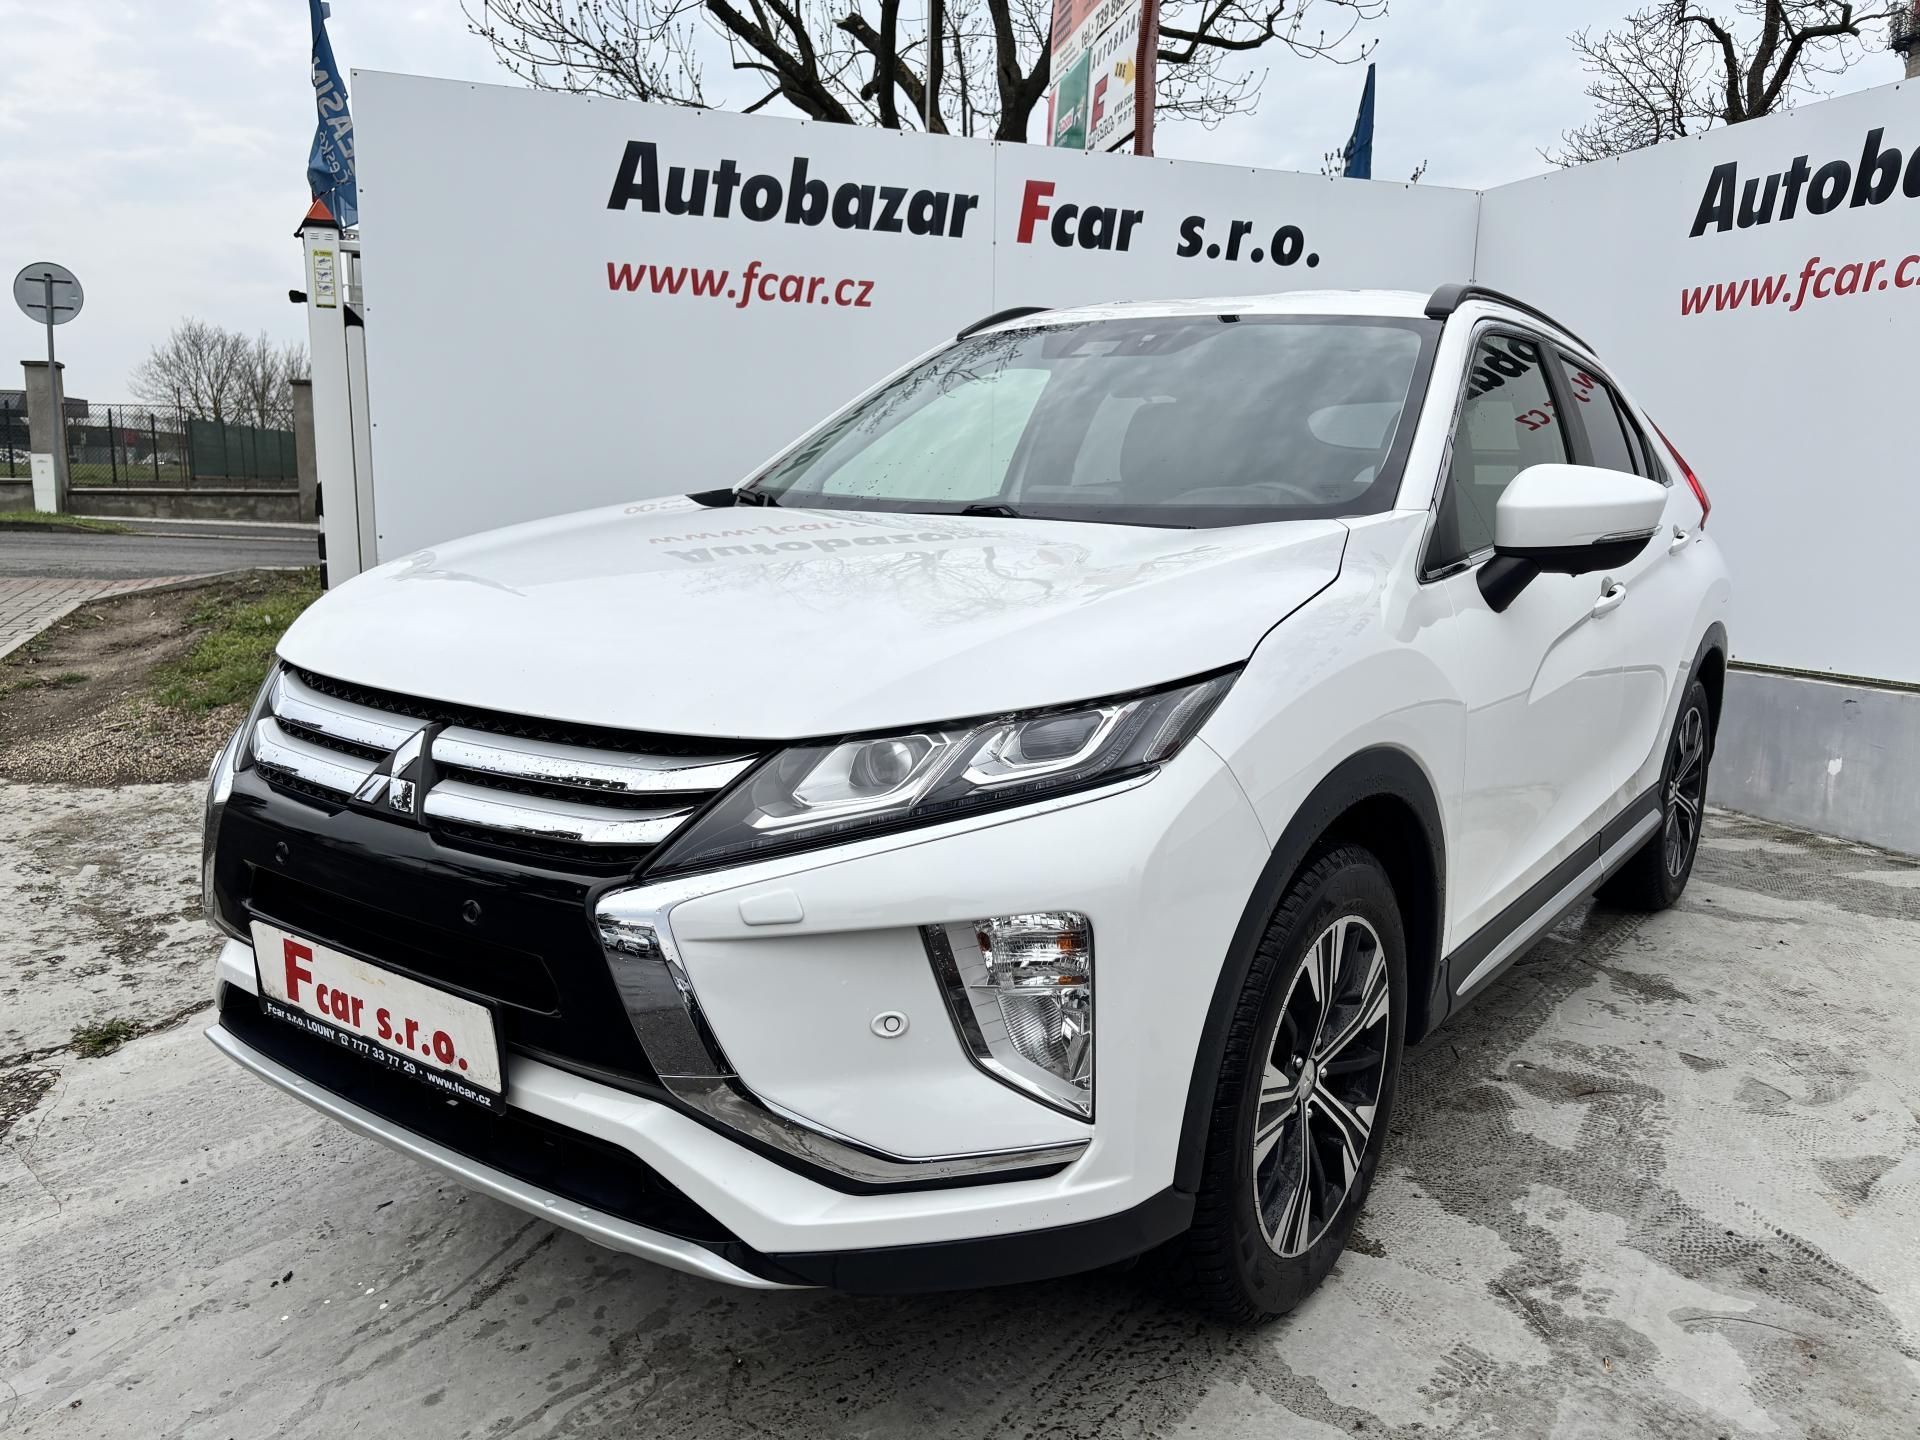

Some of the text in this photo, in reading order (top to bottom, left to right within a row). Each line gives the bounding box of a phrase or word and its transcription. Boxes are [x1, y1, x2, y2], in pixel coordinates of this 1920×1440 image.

[606, 140, 1320, 268] Autobazar Fcar s.r.o.
[606, 260, 875, 309] www.fcar.cz
[1681, 254, 1920, 316] www.fcar.c
[267, 1002, 492, 1107] Fcar s.r.o. LOUNY 777 33 77 29 www.fcar.cz
[283, 937, 468, 1071] Fcar s.r.o.
